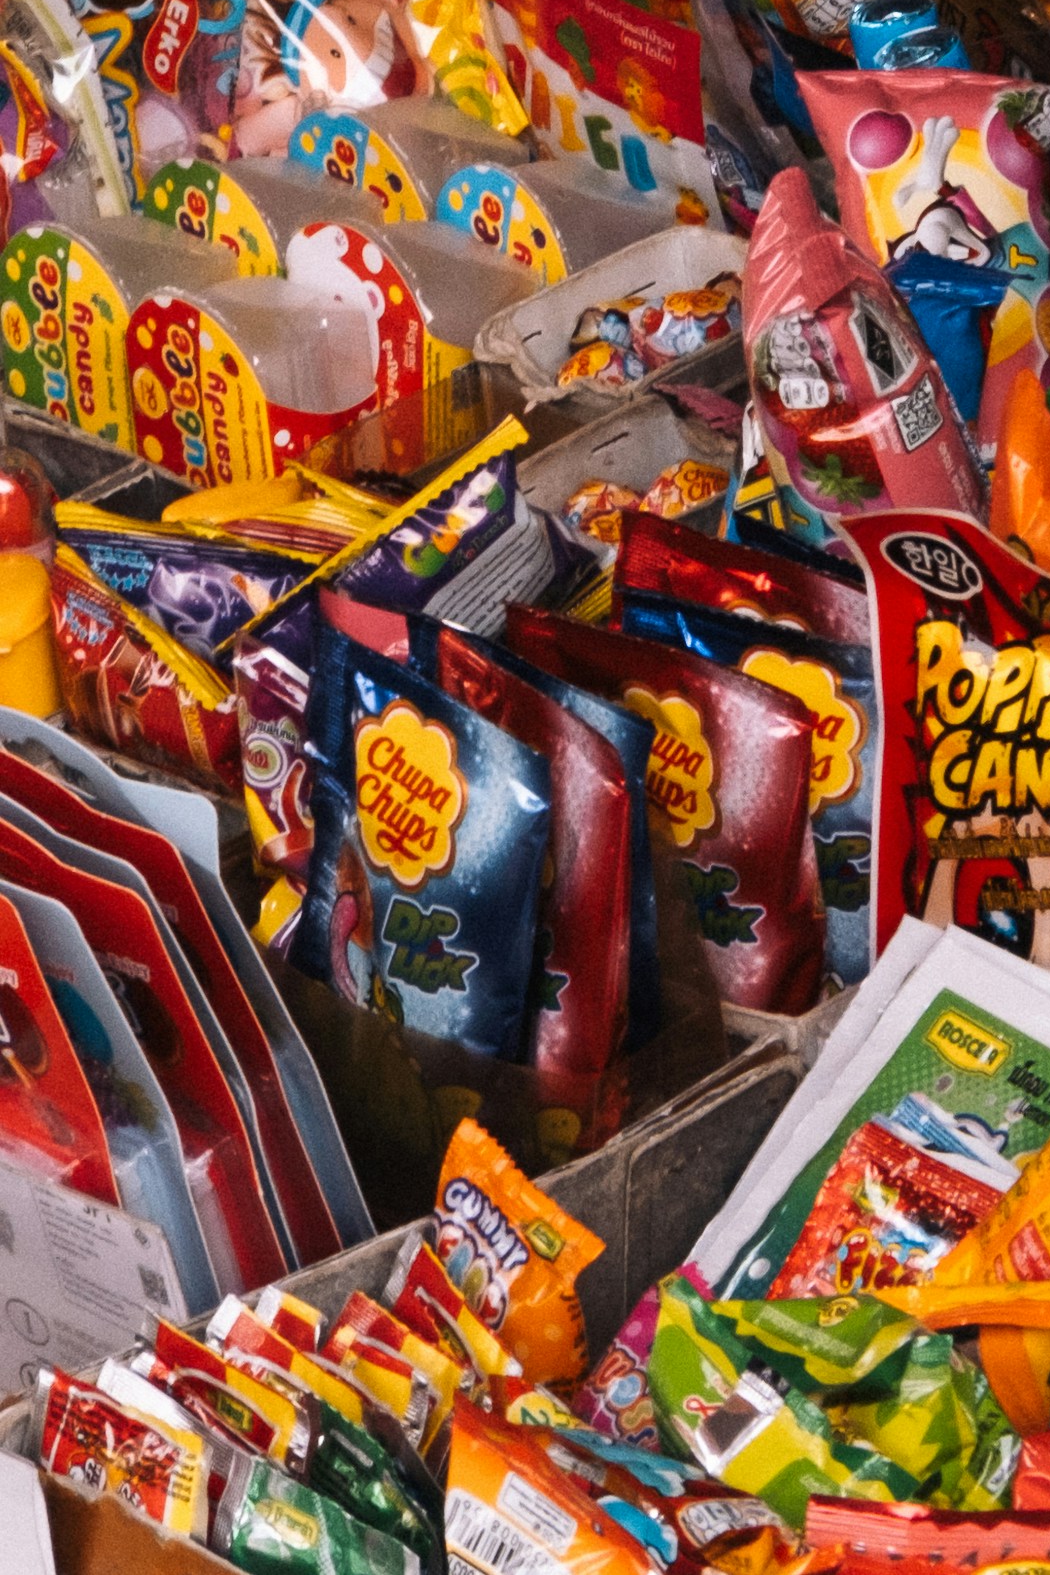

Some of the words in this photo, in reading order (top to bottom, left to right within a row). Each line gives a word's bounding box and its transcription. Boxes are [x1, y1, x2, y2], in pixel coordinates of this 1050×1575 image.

[67, 300, 96, 417] candy
[203, 369, 235, 485] candy
[900, 540, 962, 589] 한일
[366, 735, 453, 816] Chupa
[647, 769, 698, 815] ups
[653, 731, 705, 779] upa
[355, 772, 439, 858] Chups
[937, 1018, 1001, 1067] ROSCEA
[444, 1177, 530, 1272] GUMMY
